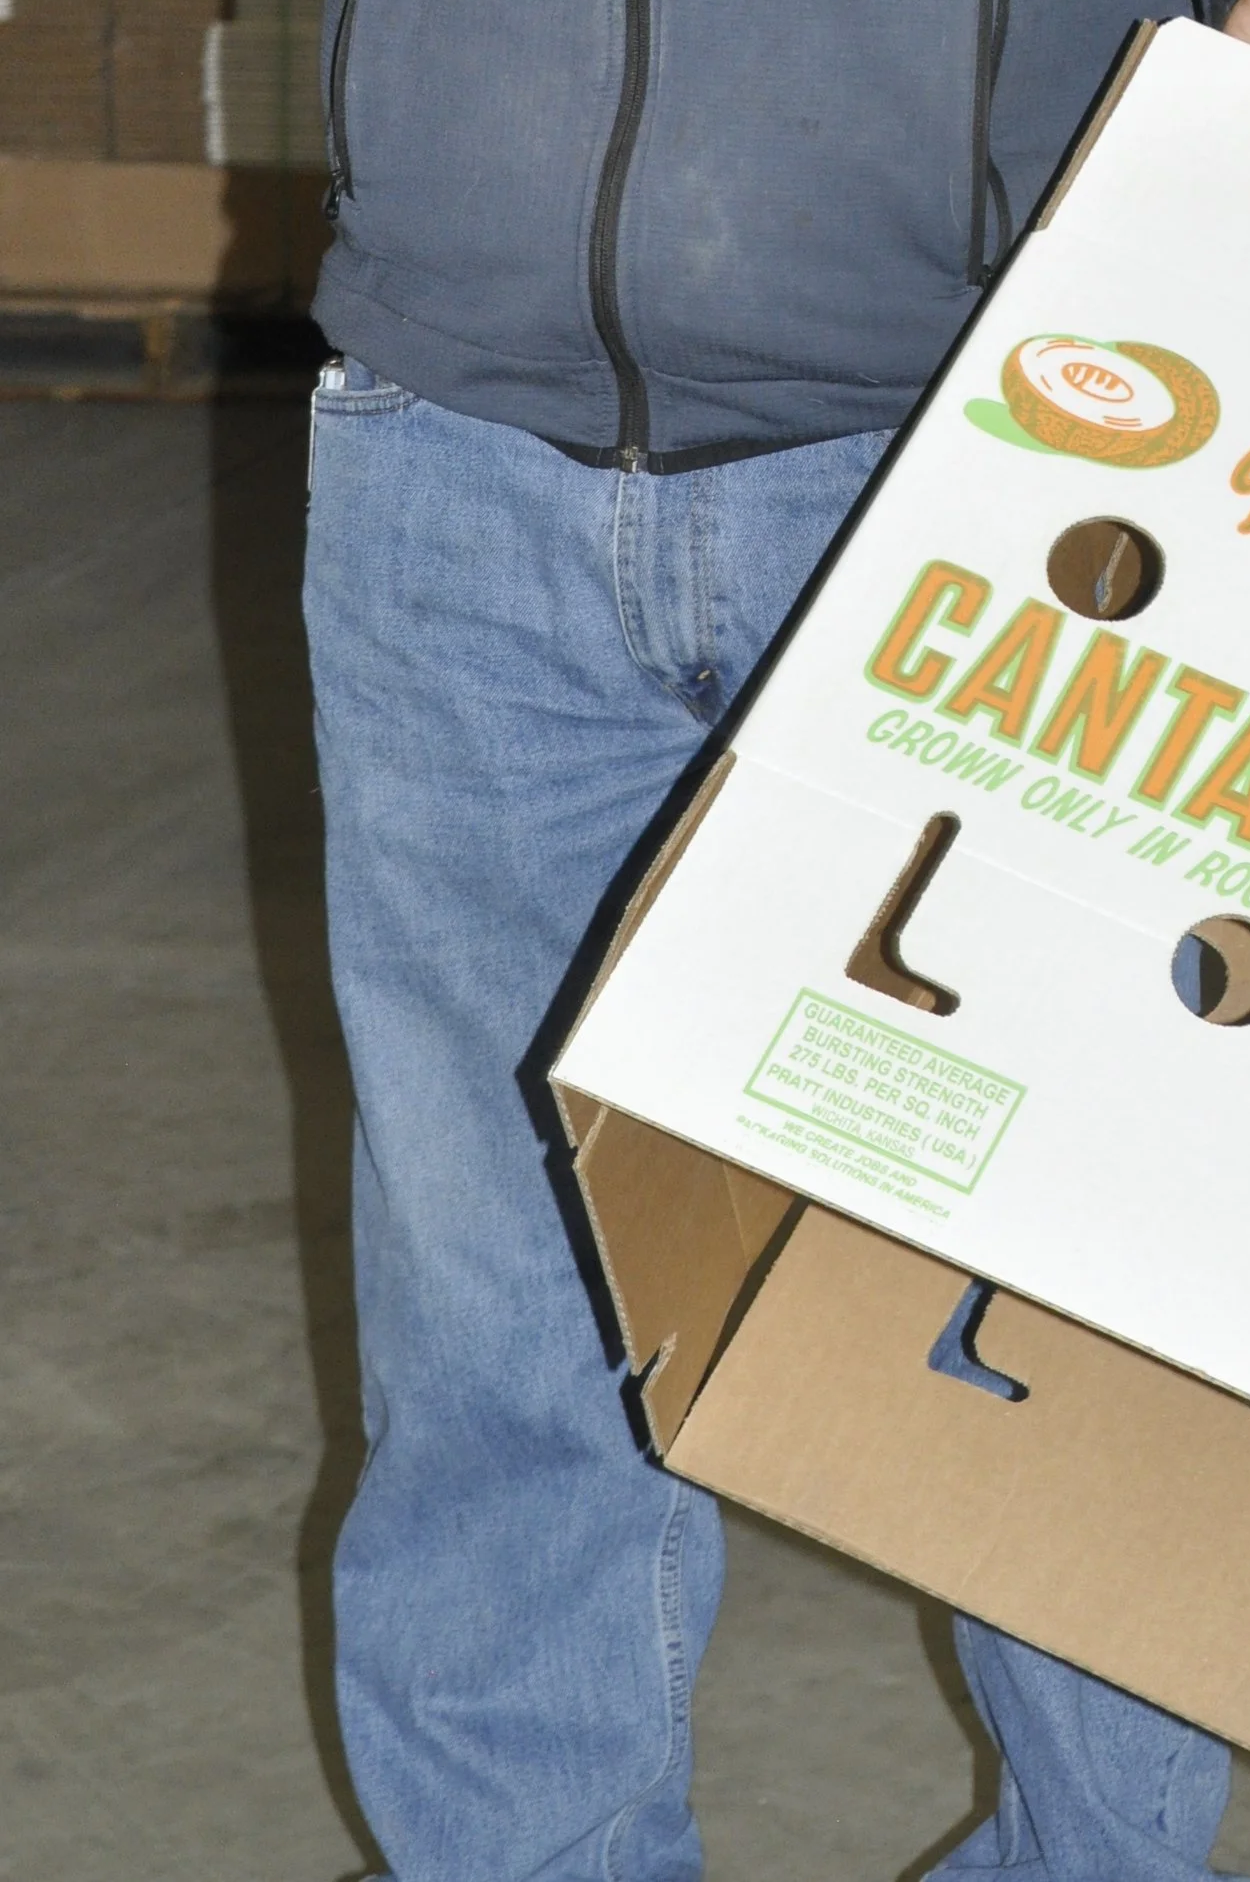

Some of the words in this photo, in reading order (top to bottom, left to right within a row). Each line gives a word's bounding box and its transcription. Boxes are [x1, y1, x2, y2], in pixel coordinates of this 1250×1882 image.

[866, 709, 1024, 793] GROWN
[1020, 775, 1138, 839] ONLY
[1126, 825, 1191, 867] IN
[788, 1044, 823, 1069] 275
[821, 1060, 859, 1088] LBS.
[864, 1077, 901, 1105] PER
[903, 1094, 932, 1120] SQ.
[935, 1108, 981, 1141] INCH
[802, 1026, 893, 1077] BURSTING
[893, 1067, 989, 1119] STRENGTH
[804, 1002, 924, 1065] GUARANTEED
[923, 1056, 1012, 1107] AVERAGE
[766, 1064, 823, 1097] PRATT
[824, 1086, 923, 1142] INDUSTRIES
[932, 1137, 968, 1165] USA
[782, 1120, 803, 1137] WE
[804, 1131, 855, 1159] CREATE
[854, 1152, 890, 1175] JOBS
[888, 1169, 918, 1188] AND
[811, 1104, 863, 1139] WICHITA,
[865, 1130, 917, 1159] KANSAS
[737, 1114, 809, 1154] PACKAGING
[809, 1148, 878, 1188] SOLUTIONS
[878, 1178, 896, 1193] IN
[893, 1185, 951, 1220] AMERICA
